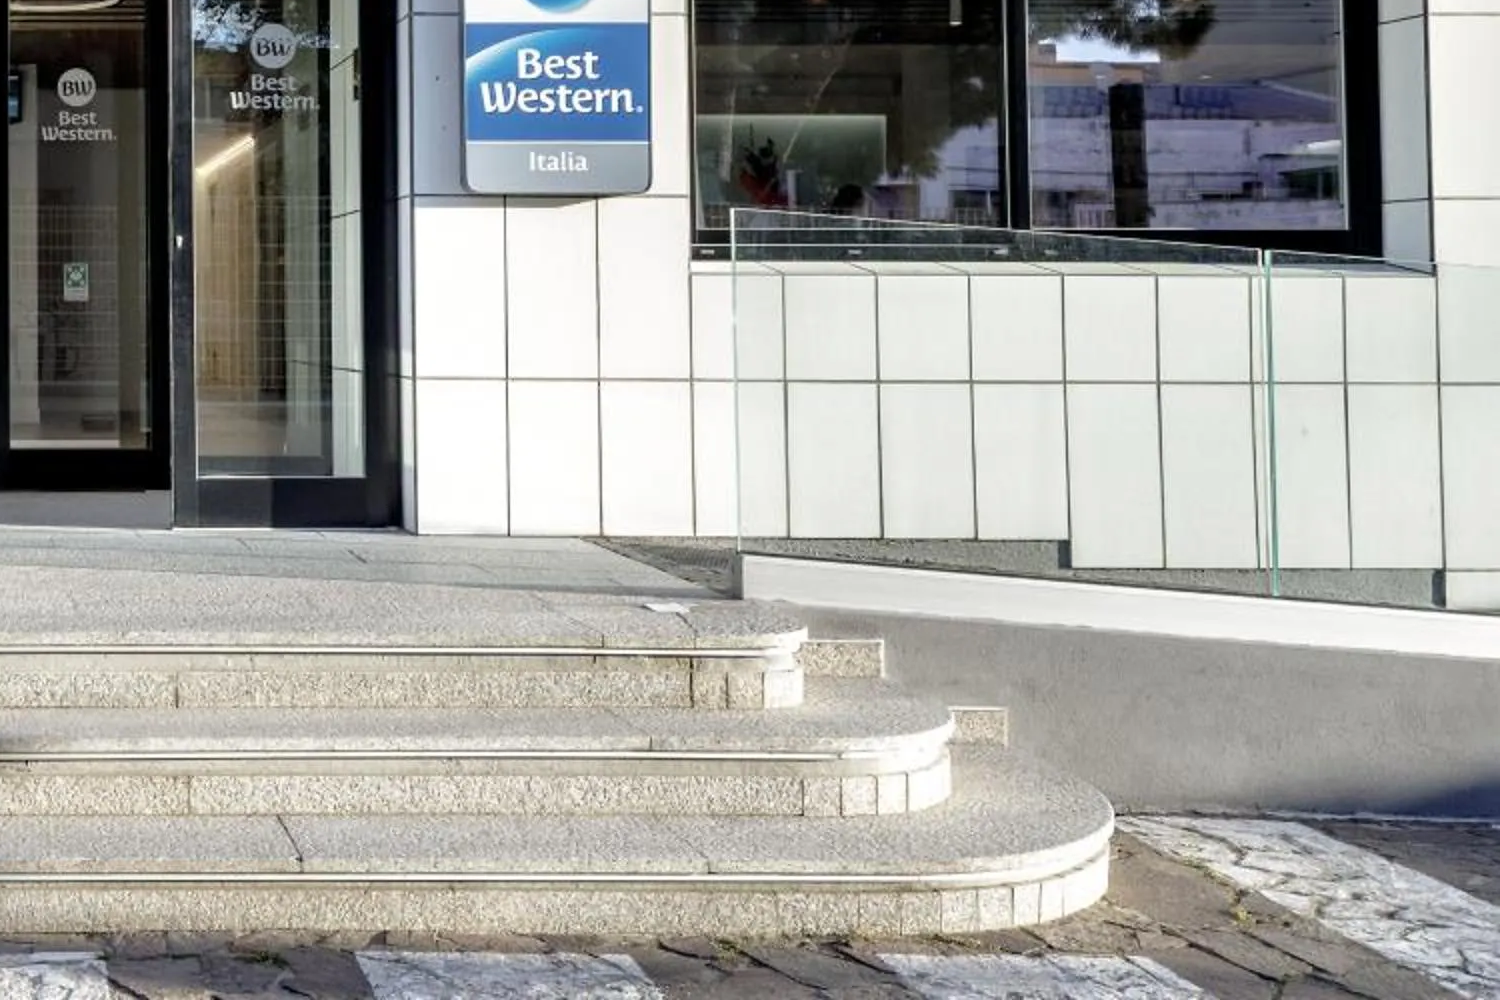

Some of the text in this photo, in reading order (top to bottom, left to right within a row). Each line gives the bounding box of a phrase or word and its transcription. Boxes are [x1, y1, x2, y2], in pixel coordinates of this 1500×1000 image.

[256, 37, 292, 57] BW
[517, 48, 600, 80] Best
[63, 80, 93, 97] BW
[251, 73, 298, 92] Best
[58, 111, 98, 126] Best
[529, 151, 589, 172] Italia
